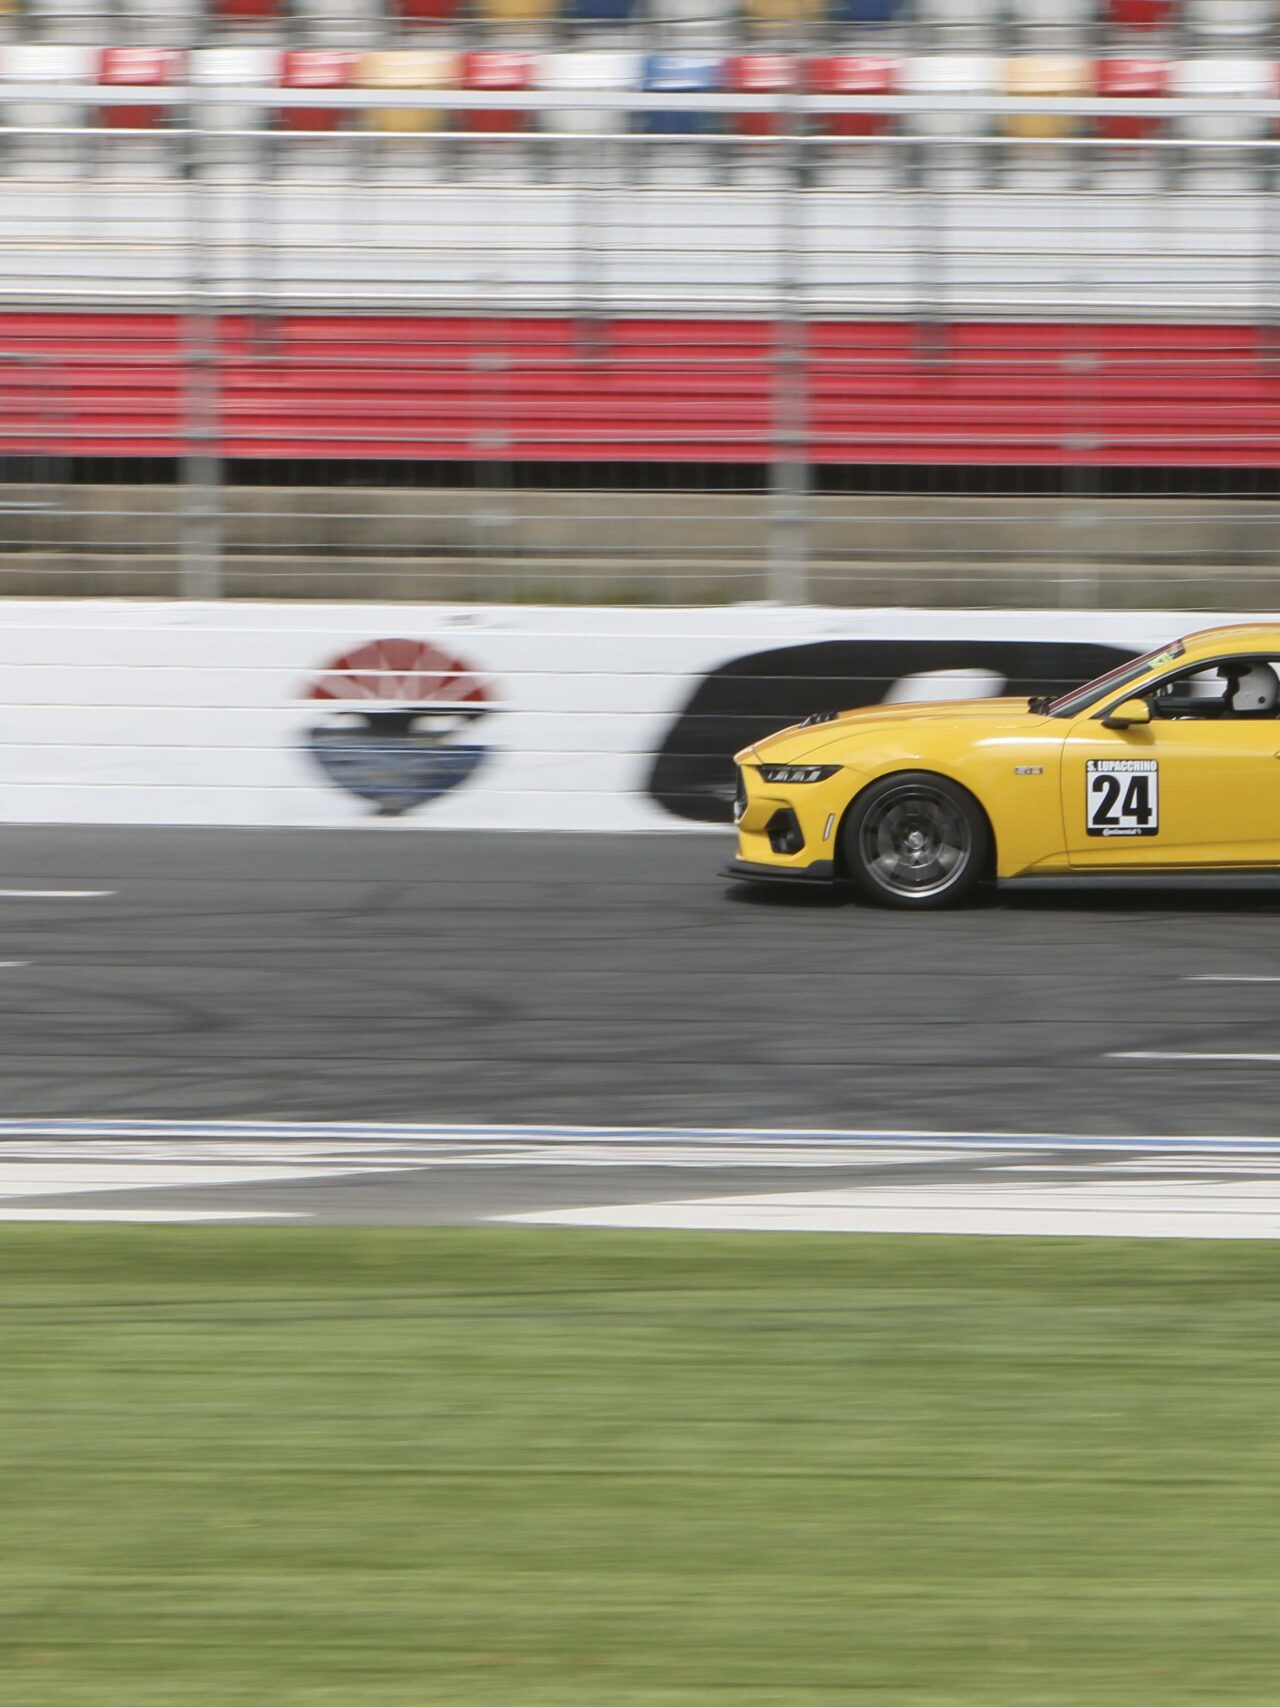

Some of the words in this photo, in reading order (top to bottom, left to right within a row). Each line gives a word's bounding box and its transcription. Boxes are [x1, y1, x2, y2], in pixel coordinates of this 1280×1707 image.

[1087, 760, 1096, 772] S.
[1098, 760, 1157, 772] LUPACCHINO
[1092, 774, 1152, 825] 24
